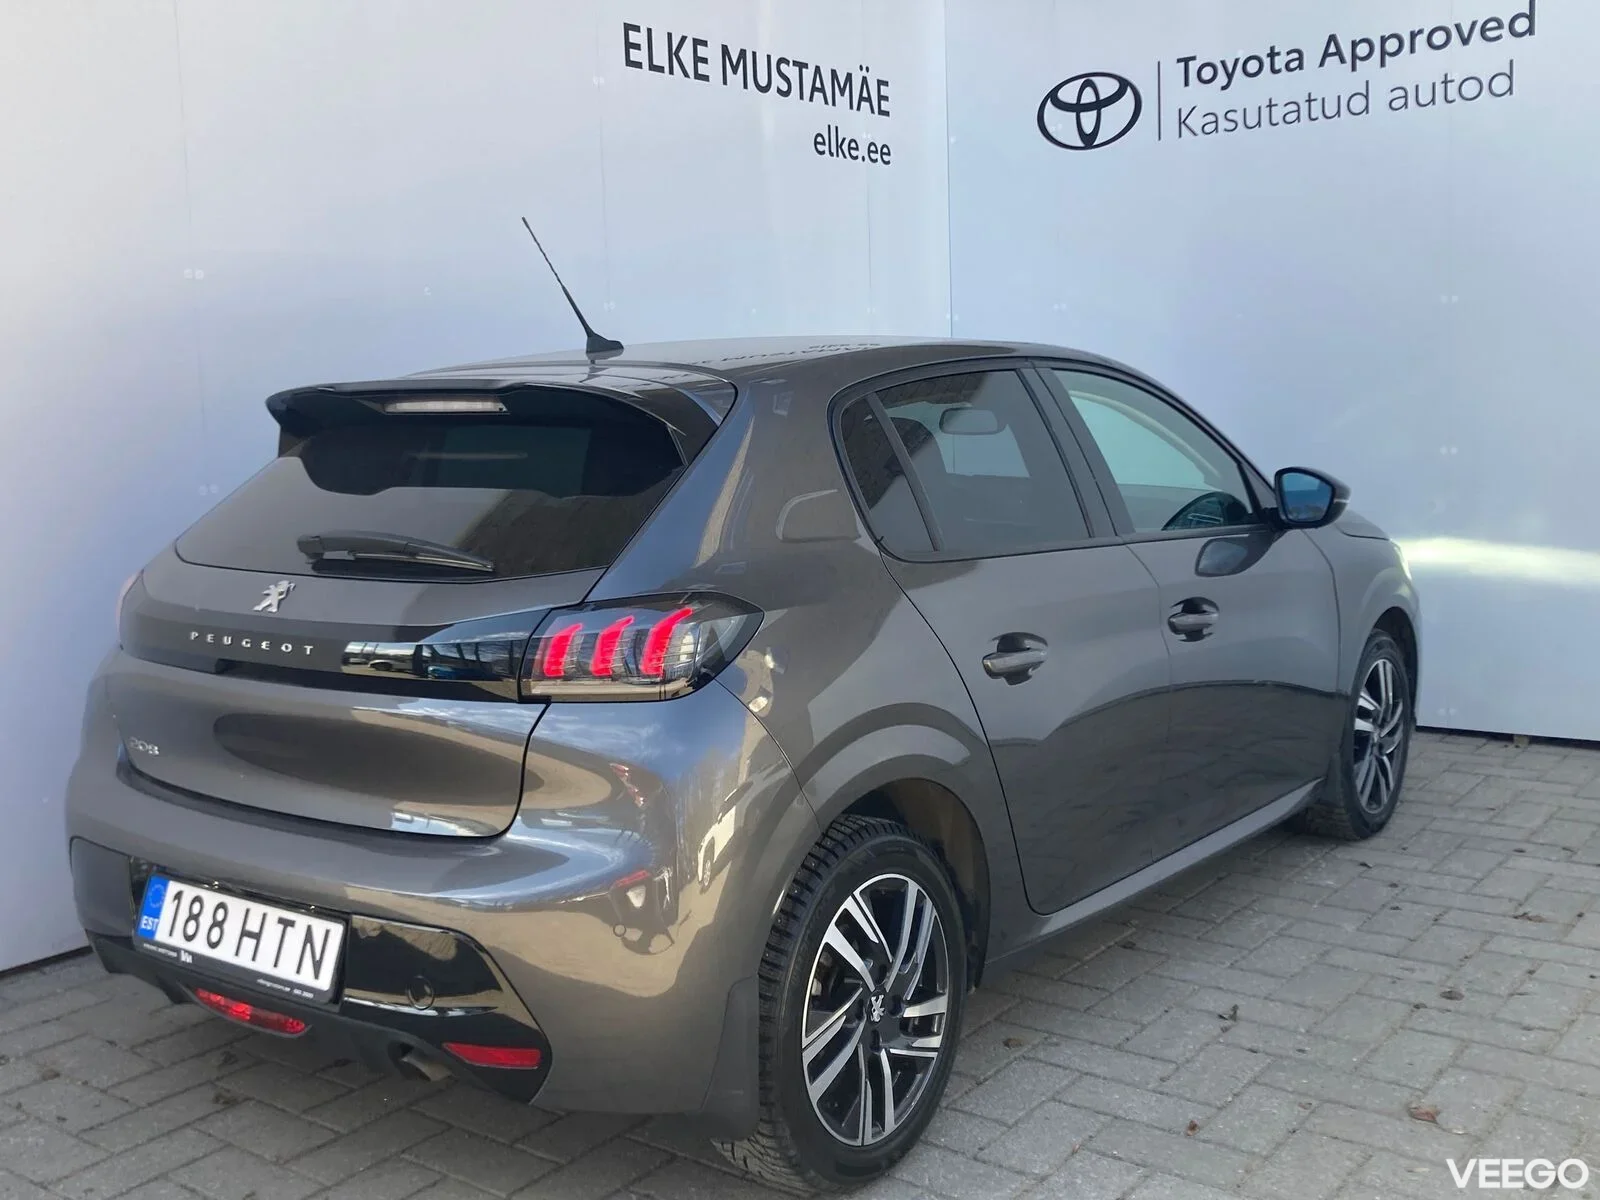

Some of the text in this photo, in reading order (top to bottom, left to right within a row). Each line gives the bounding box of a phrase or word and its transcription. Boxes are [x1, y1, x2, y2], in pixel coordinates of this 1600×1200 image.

[623, 22, 891, 118] ELKE MUSTAMÄE
[1176, 0, 1536, 92] Toyota Approved
[1177, 59, 1515, 139] Kasutatud autod
[813, 124, 892, 165] elke.ee
[189, 631, 314, 656] PEUGEOT
[140, 915, 160, 932] EST
[168, 889, 331, 980] 188 HTN
